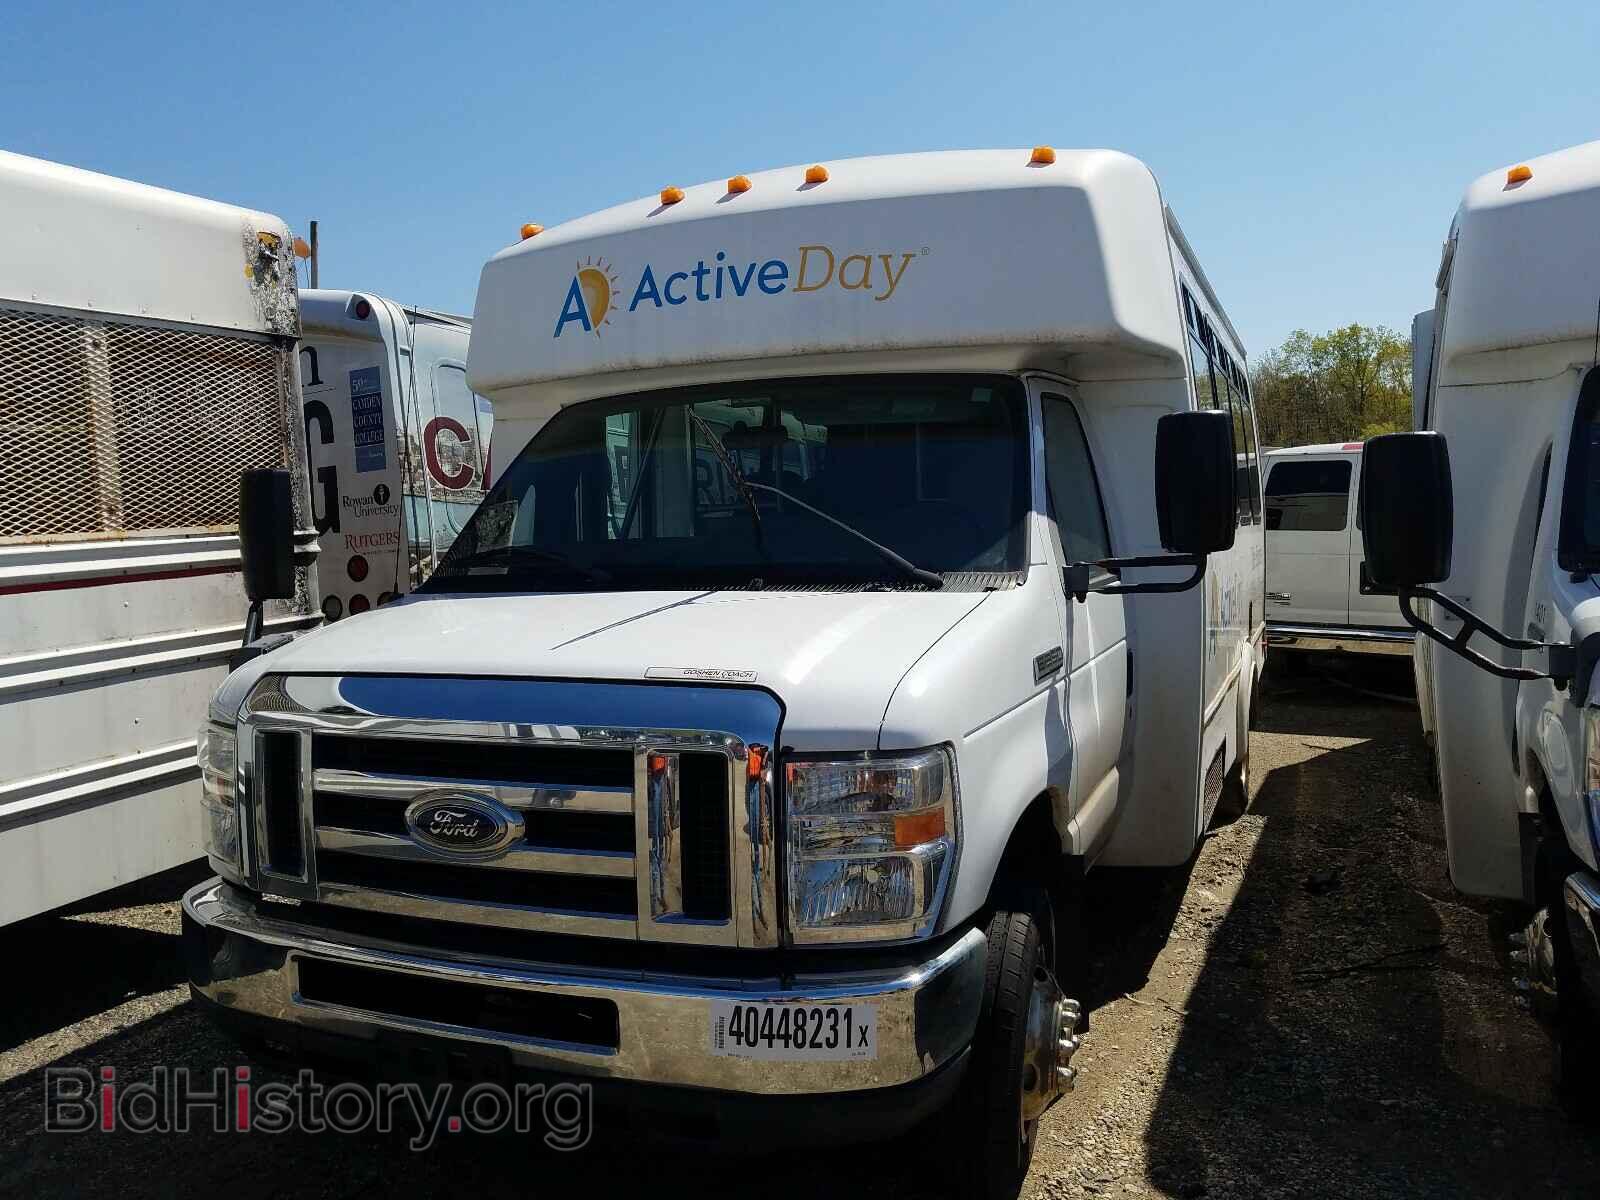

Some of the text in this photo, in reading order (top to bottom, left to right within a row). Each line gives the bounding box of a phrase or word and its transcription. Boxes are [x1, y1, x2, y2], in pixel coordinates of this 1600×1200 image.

[342, 495, 374, 508] Rowan
[354, 503, 399, 518] University
[344, 531, 400, 553] RUTGERS
[683, 669, 720, 677] GOSHEN
[721, 671, 753, 679] COACH
[430, 809, 479, 838] Ford
[728, 1005, 853, 1050] 40448231
